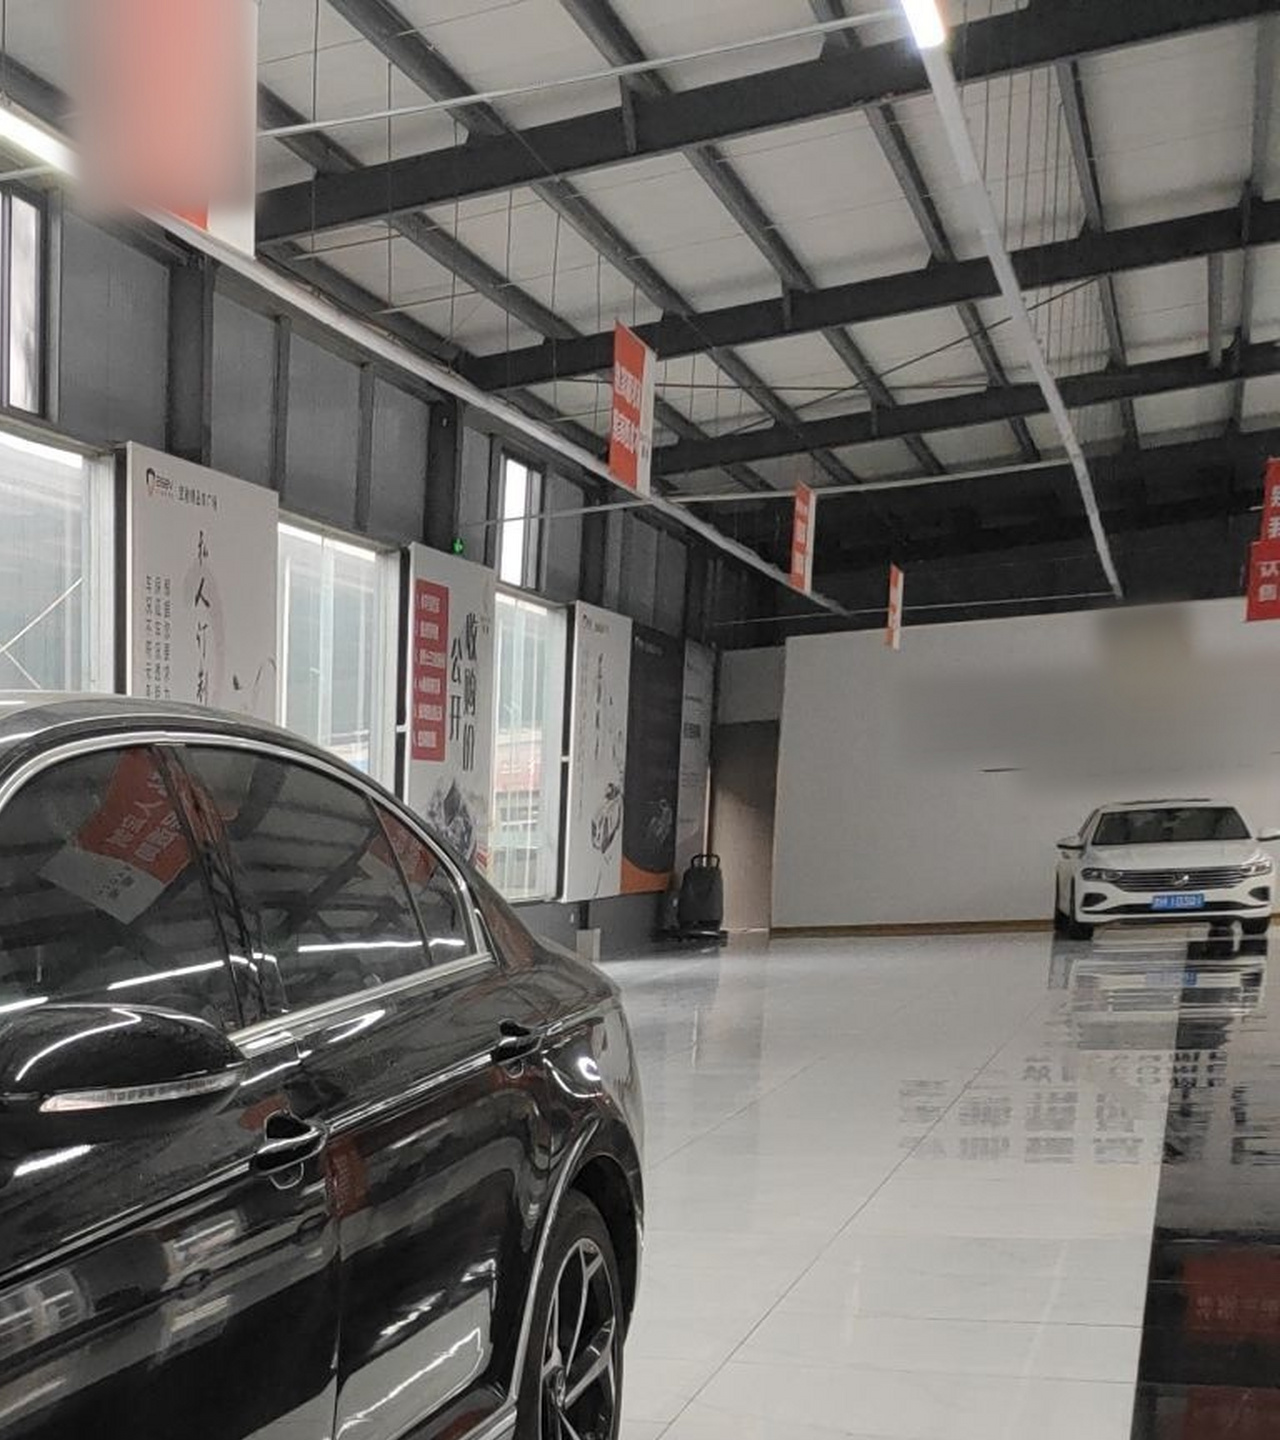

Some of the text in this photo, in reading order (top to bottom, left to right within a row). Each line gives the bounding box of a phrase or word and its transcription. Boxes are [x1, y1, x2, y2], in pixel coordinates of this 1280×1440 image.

[450, 637, 463, 742] 公开
[463, 612, 478, 772] 收购价
